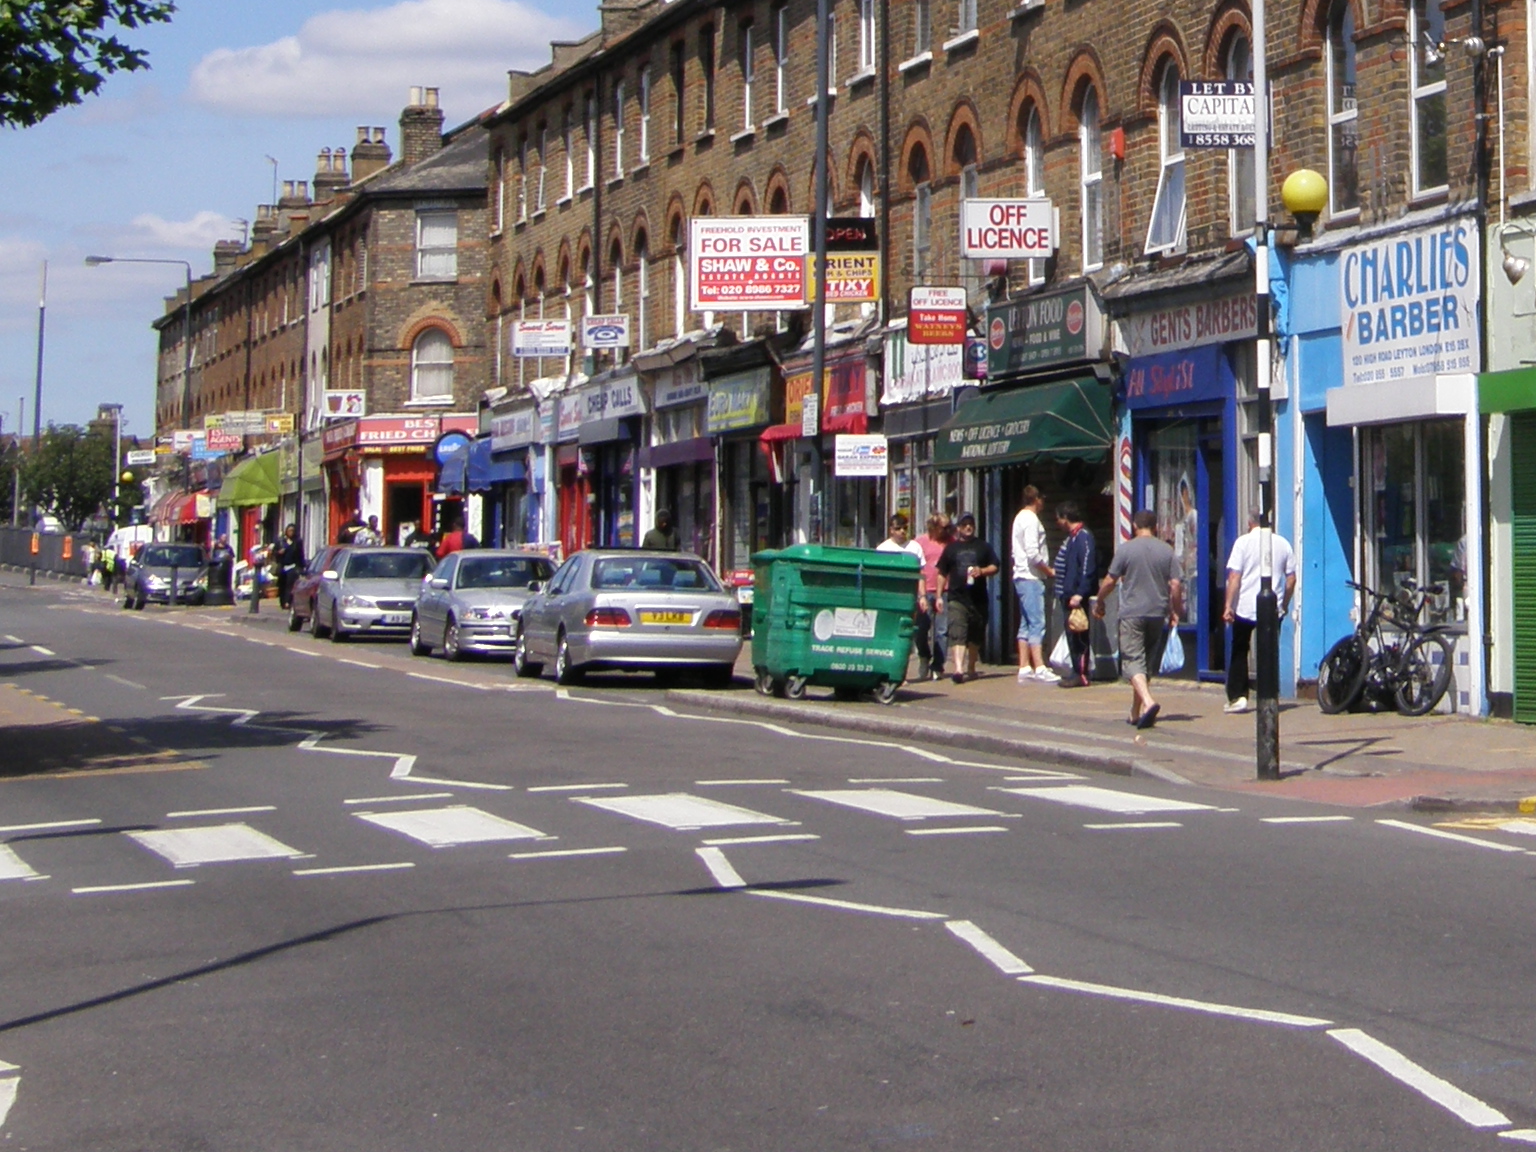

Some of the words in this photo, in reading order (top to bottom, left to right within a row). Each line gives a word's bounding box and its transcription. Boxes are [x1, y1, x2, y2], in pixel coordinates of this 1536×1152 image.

[1191, 83, 1226, 94] LET
[1234, 83, 1255, 94] BY
[1195, 134, 1229, 145] 8558
[1232, 134, 1255, 145] 368
[990, 204, 1027, 226] OFF
[701, 238, 741, 253] FOR
[749, 237, 802, 252] SALE
[968, 228, 1049, 249] LICENCE
[701, 259, 751, 272] SHAW
[755, 258, 769, 271] &
[773, 258, 800, 271] Co.
[1344, 227, 1469, 309] CHARLIES
[701, 286, 720, 295] Tel:
[721, 285, 743, 294] 020
[774, 284, 801, 293] 7327
[931, 298, 963, 306] LICENCE
[1040, 297, 1063, 325] FOOD
[1196, 295, 1258, 338] BARBERS
[1358, 295, 1459, 345] BARBER
[1393, 347, 1417, 360] LEYTON
[361, 431, 407, 440] FRIED
[812, 644, 834, 653] TRADE
[836, 646, 863, 655] REFUSE
[865, 648, 894, 658] SERVICE
